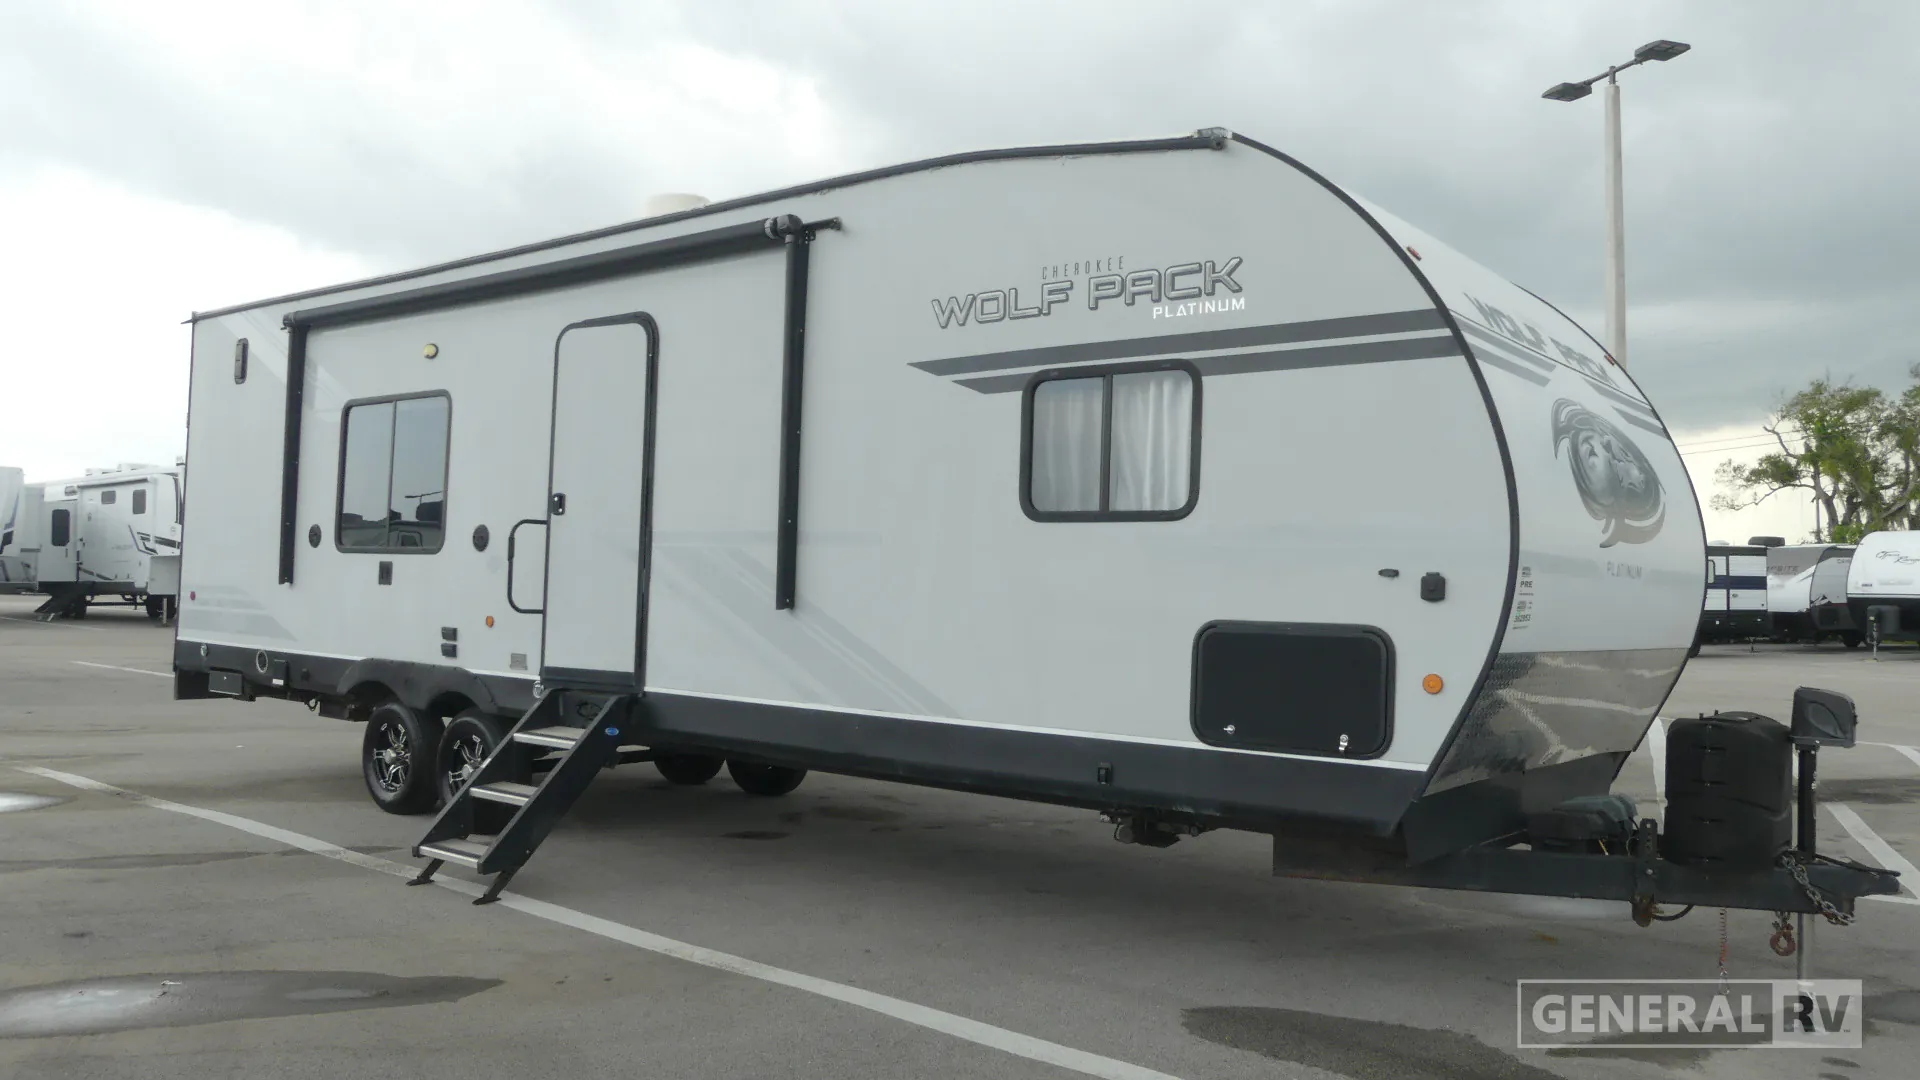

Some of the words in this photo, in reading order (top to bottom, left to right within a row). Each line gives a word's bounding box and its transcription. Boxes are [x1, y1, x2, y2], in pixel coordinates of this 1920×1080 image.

[1042, 256, 1124, 280] CHEROKEE
[931, 280, 1073, 329] WOLF
[1088, 256, 1243, 311] PACK
[1152, 297, 1246, 320] PLATINUM
